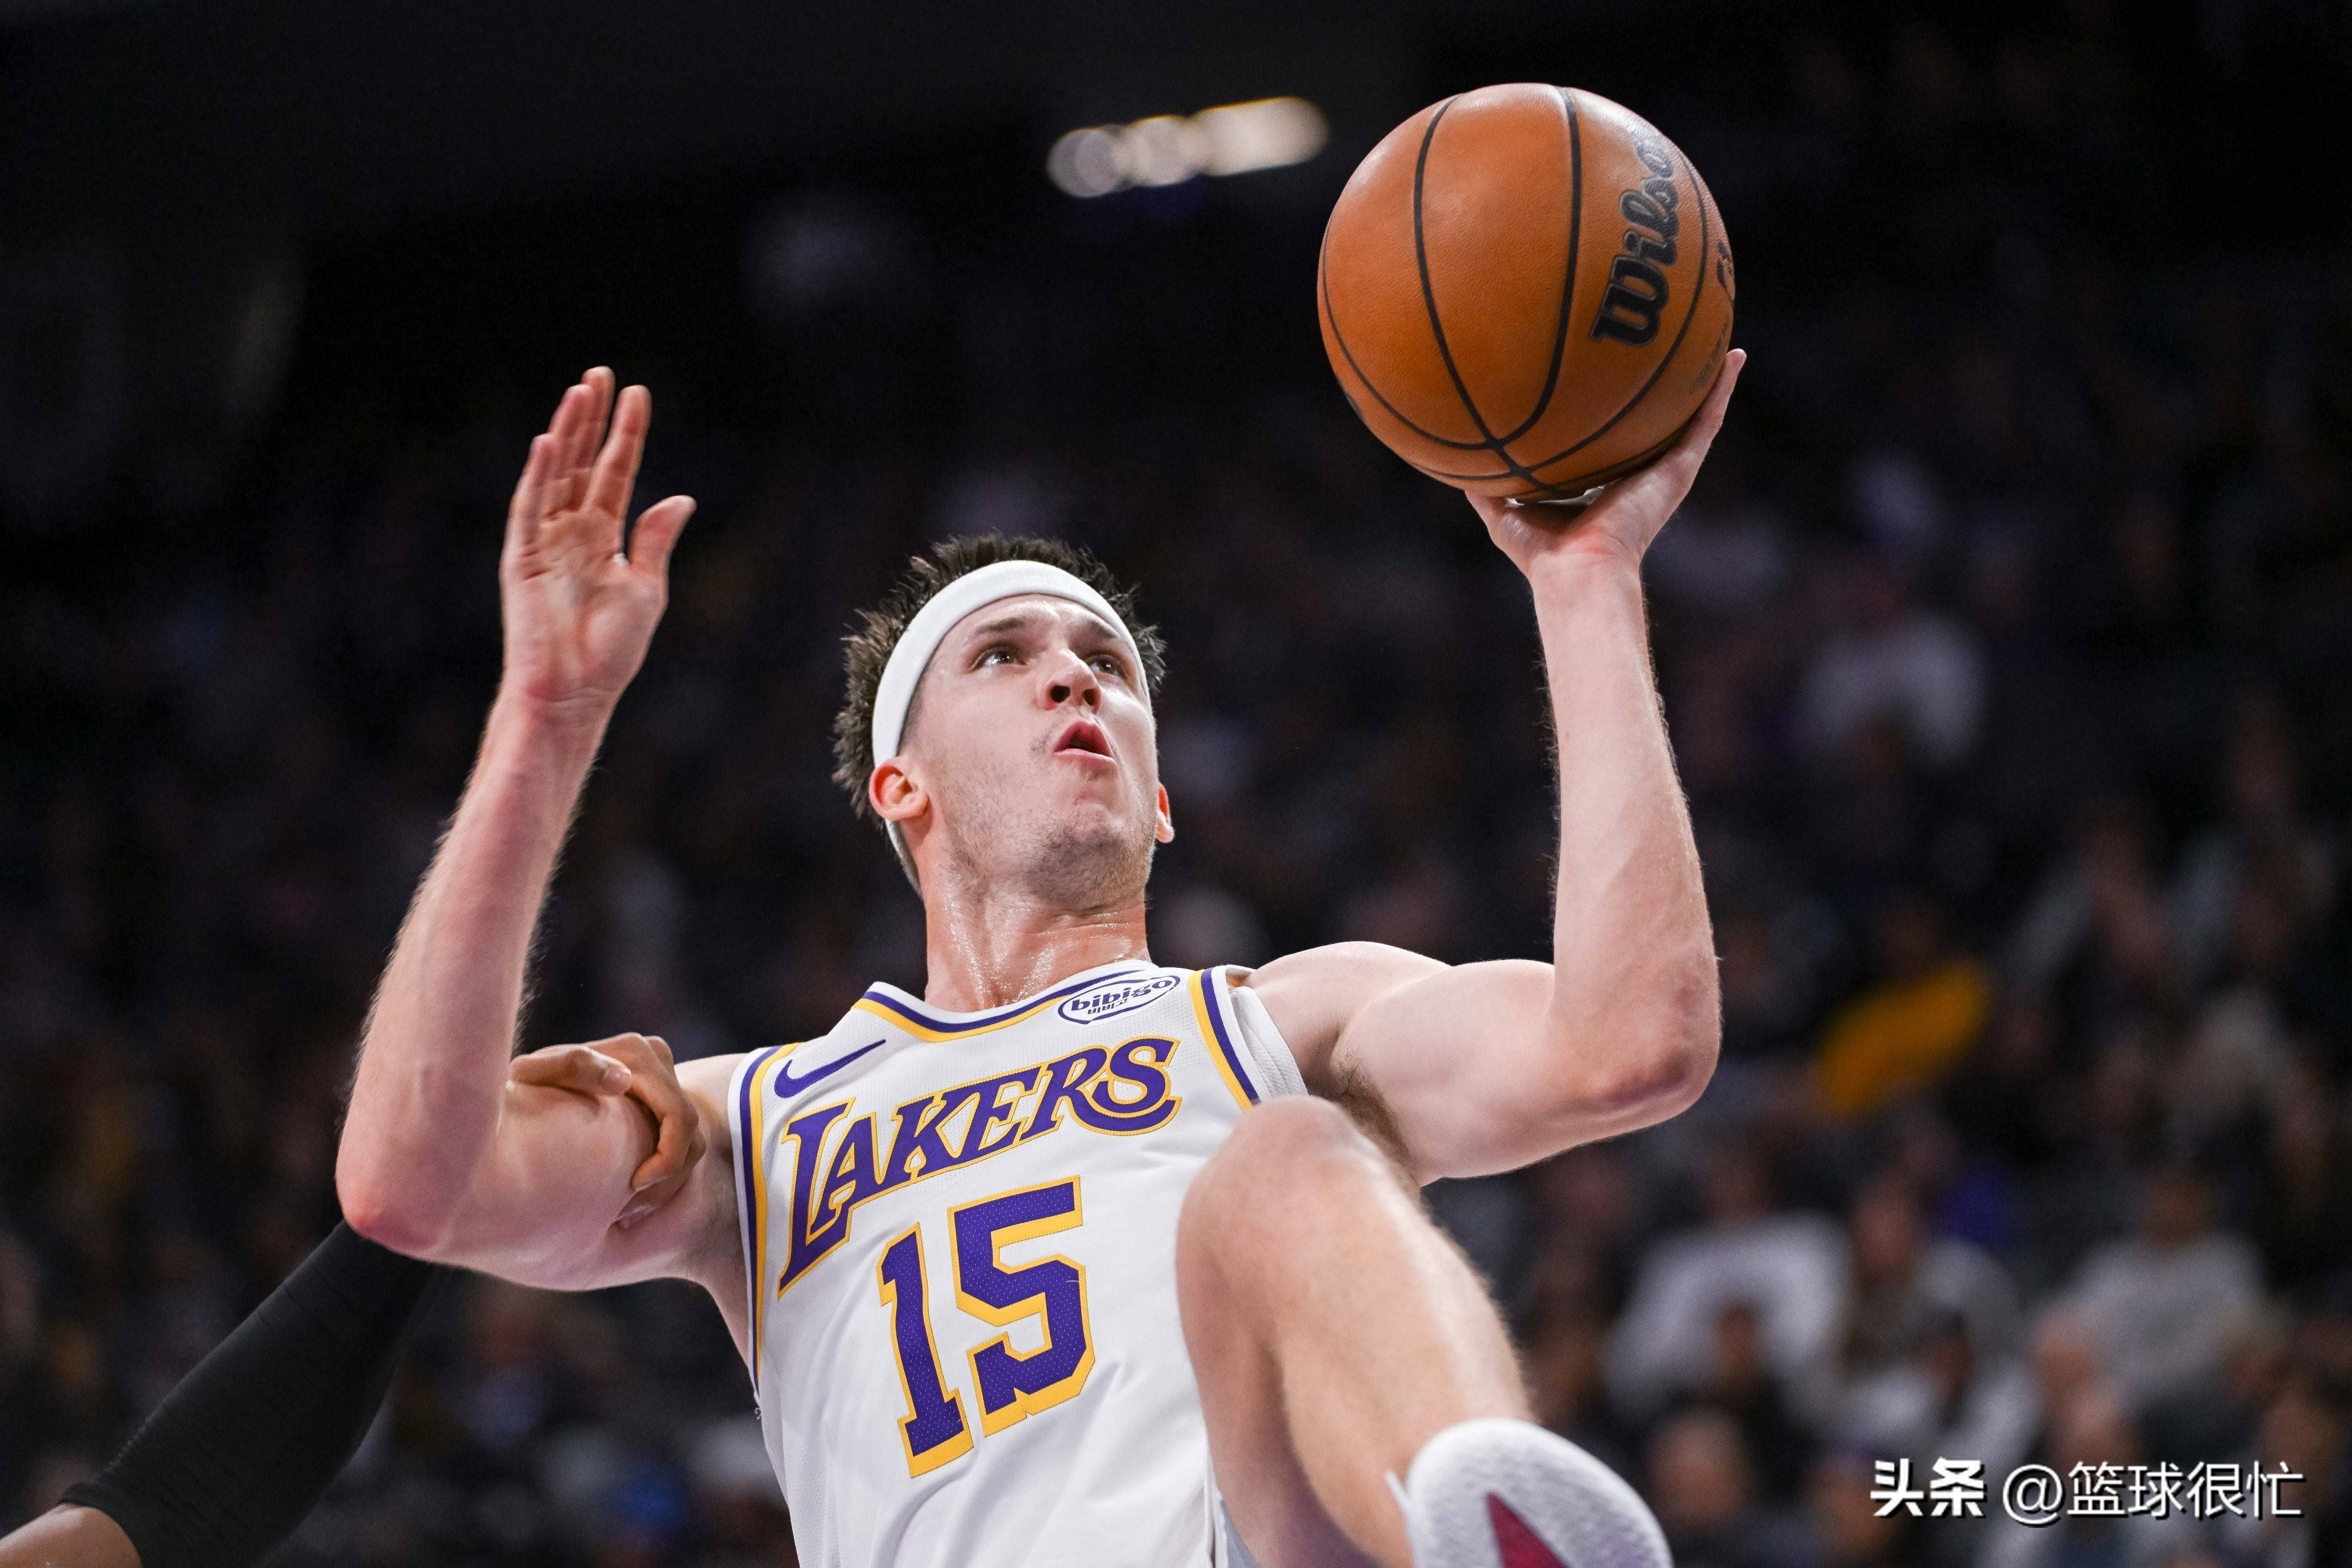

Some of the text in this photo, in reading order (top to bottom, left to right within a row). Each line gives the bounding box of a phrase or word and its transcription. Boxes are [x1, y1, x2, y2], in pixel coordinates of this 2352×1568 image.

[1589, 129, 1680, 346] Wilso
[1071, 980, 1172, 1011] bibigo
[777, 1036, 1182, 1301] LAKERS
[877, 1175, 1095, 1478] 15
